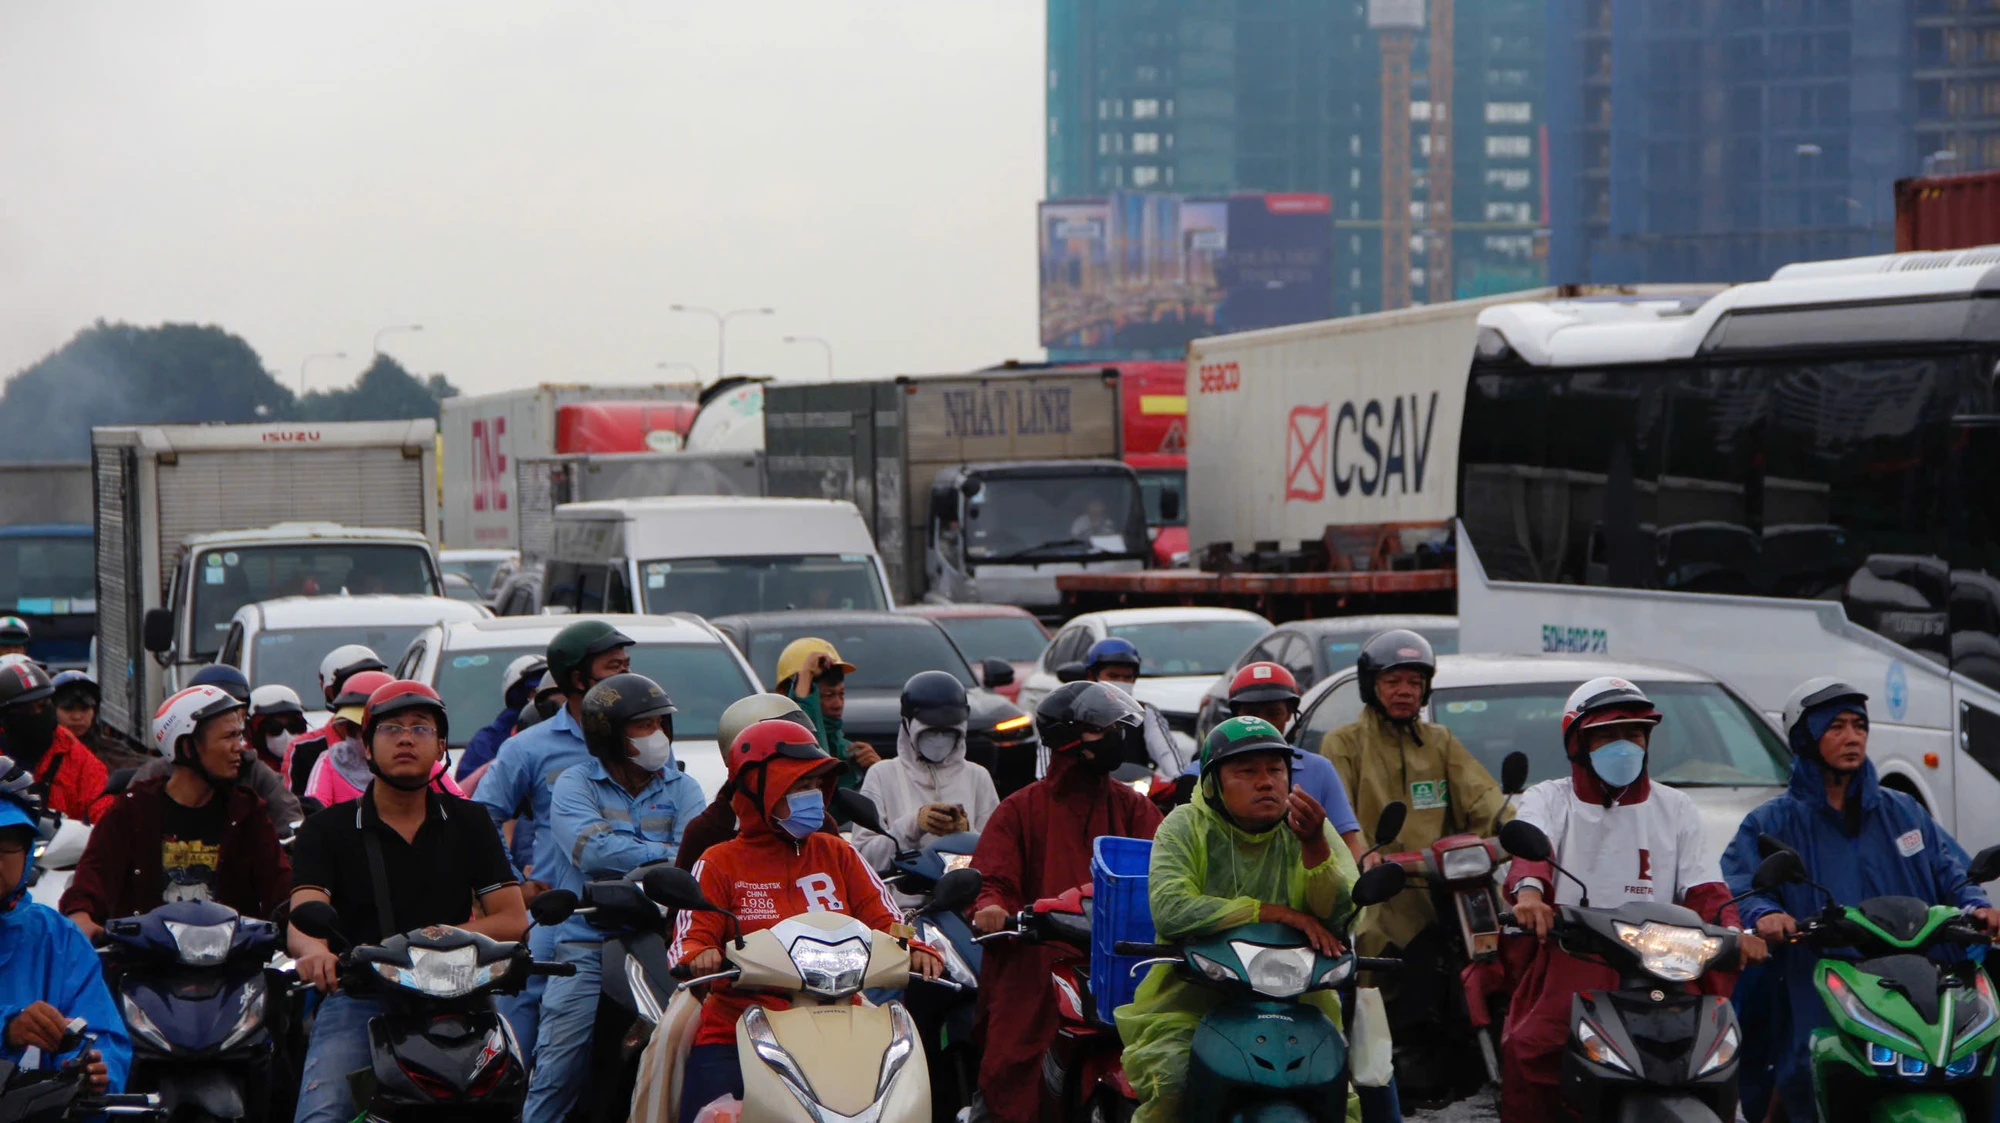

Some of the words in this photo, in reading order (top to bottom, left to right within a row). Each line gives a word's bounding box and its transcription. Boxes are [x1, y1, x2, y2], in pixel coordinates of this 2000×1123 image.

[262, 431, 320, 442] ISUZU
[1332, 390, 1439, 498] CSAV
[746, 890, 768, 898] CHINA
[741, 898, 775, 909] 1986
[1257, 1014, 1294, 1022] HONDA
